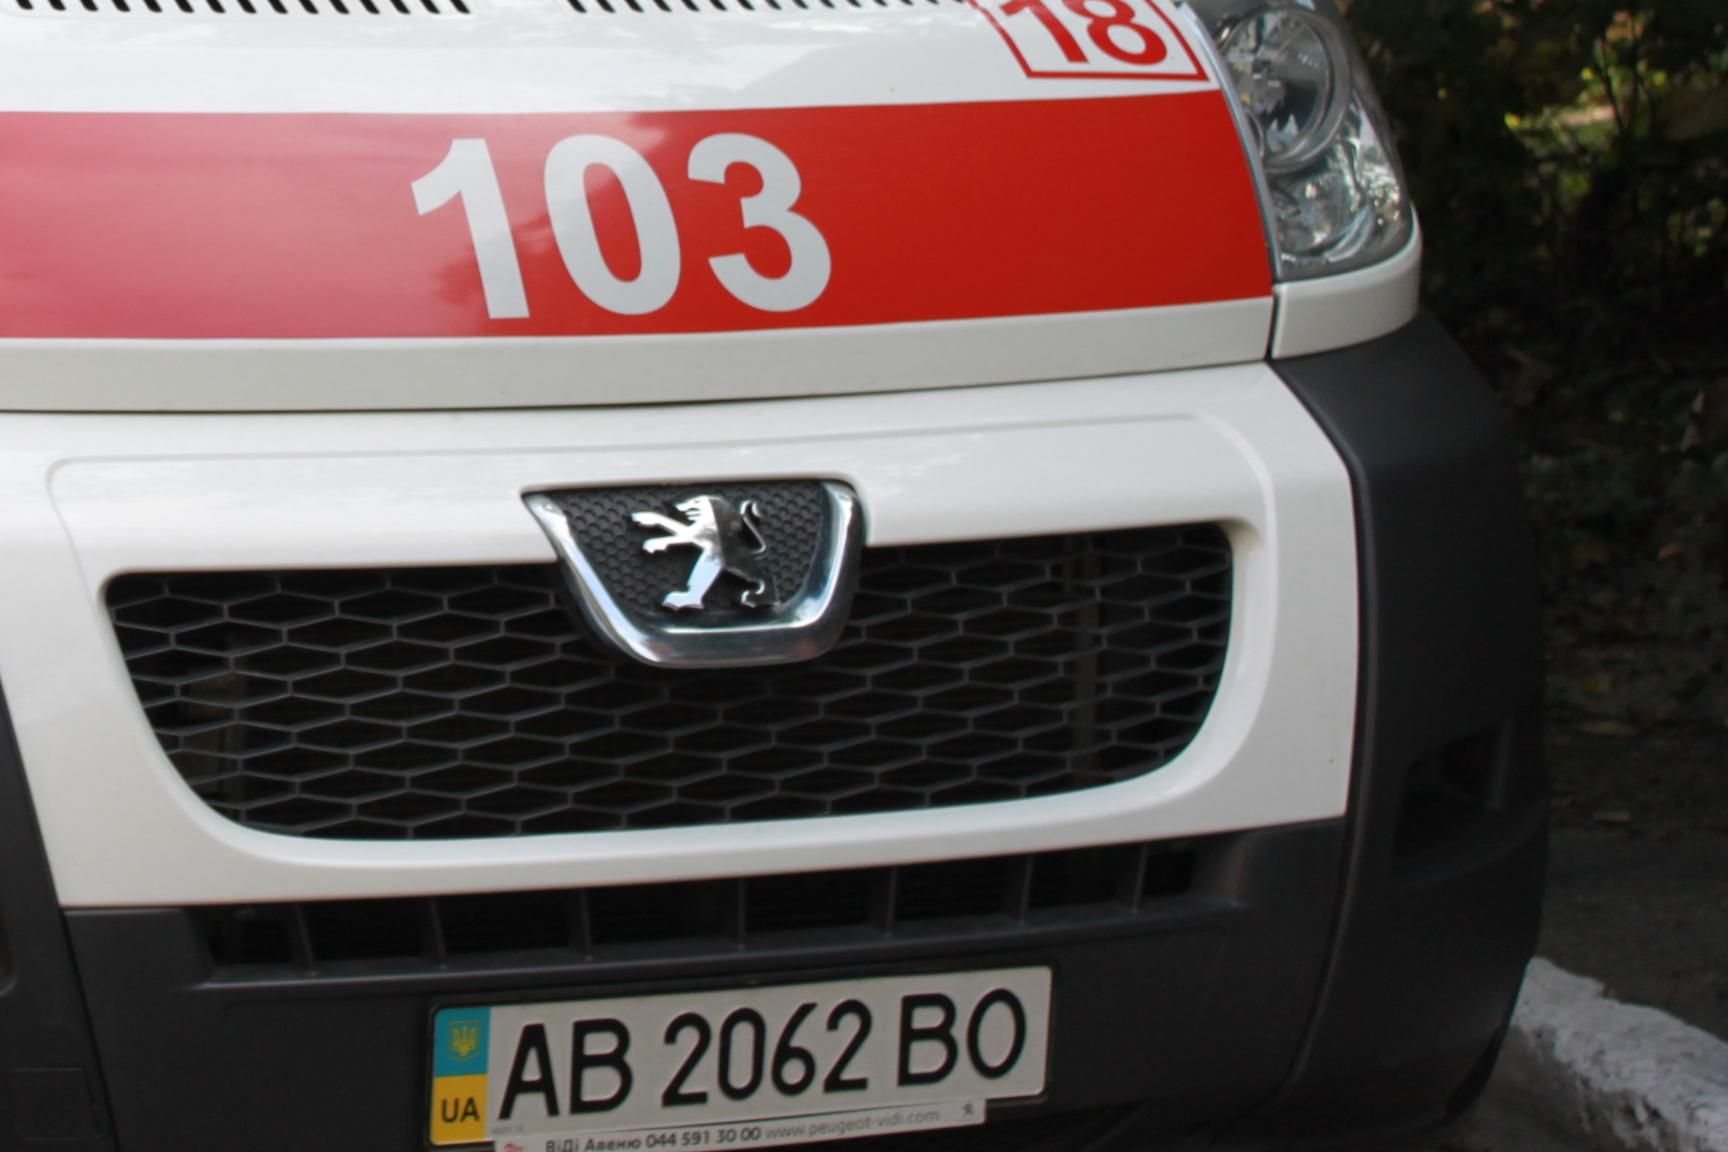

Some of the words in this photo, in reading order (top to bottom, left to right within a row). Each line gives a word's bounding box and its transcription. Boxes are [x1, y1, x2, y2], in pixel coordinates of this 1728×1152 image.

[410, 132, 832, 320] 103
[498, 1018, 633, 1120] AB
[661, 999, 873, 1108] 2062
[897, 988, 1027, 1087] BO
[441, 1096, 481, 1123] UA
[646, 1133, 677, 1149] 044
[682, 1130, 710, 1145] 591
[717, 1128, 736, 1143] 30
[740, 1126, 761, 1142] 00
